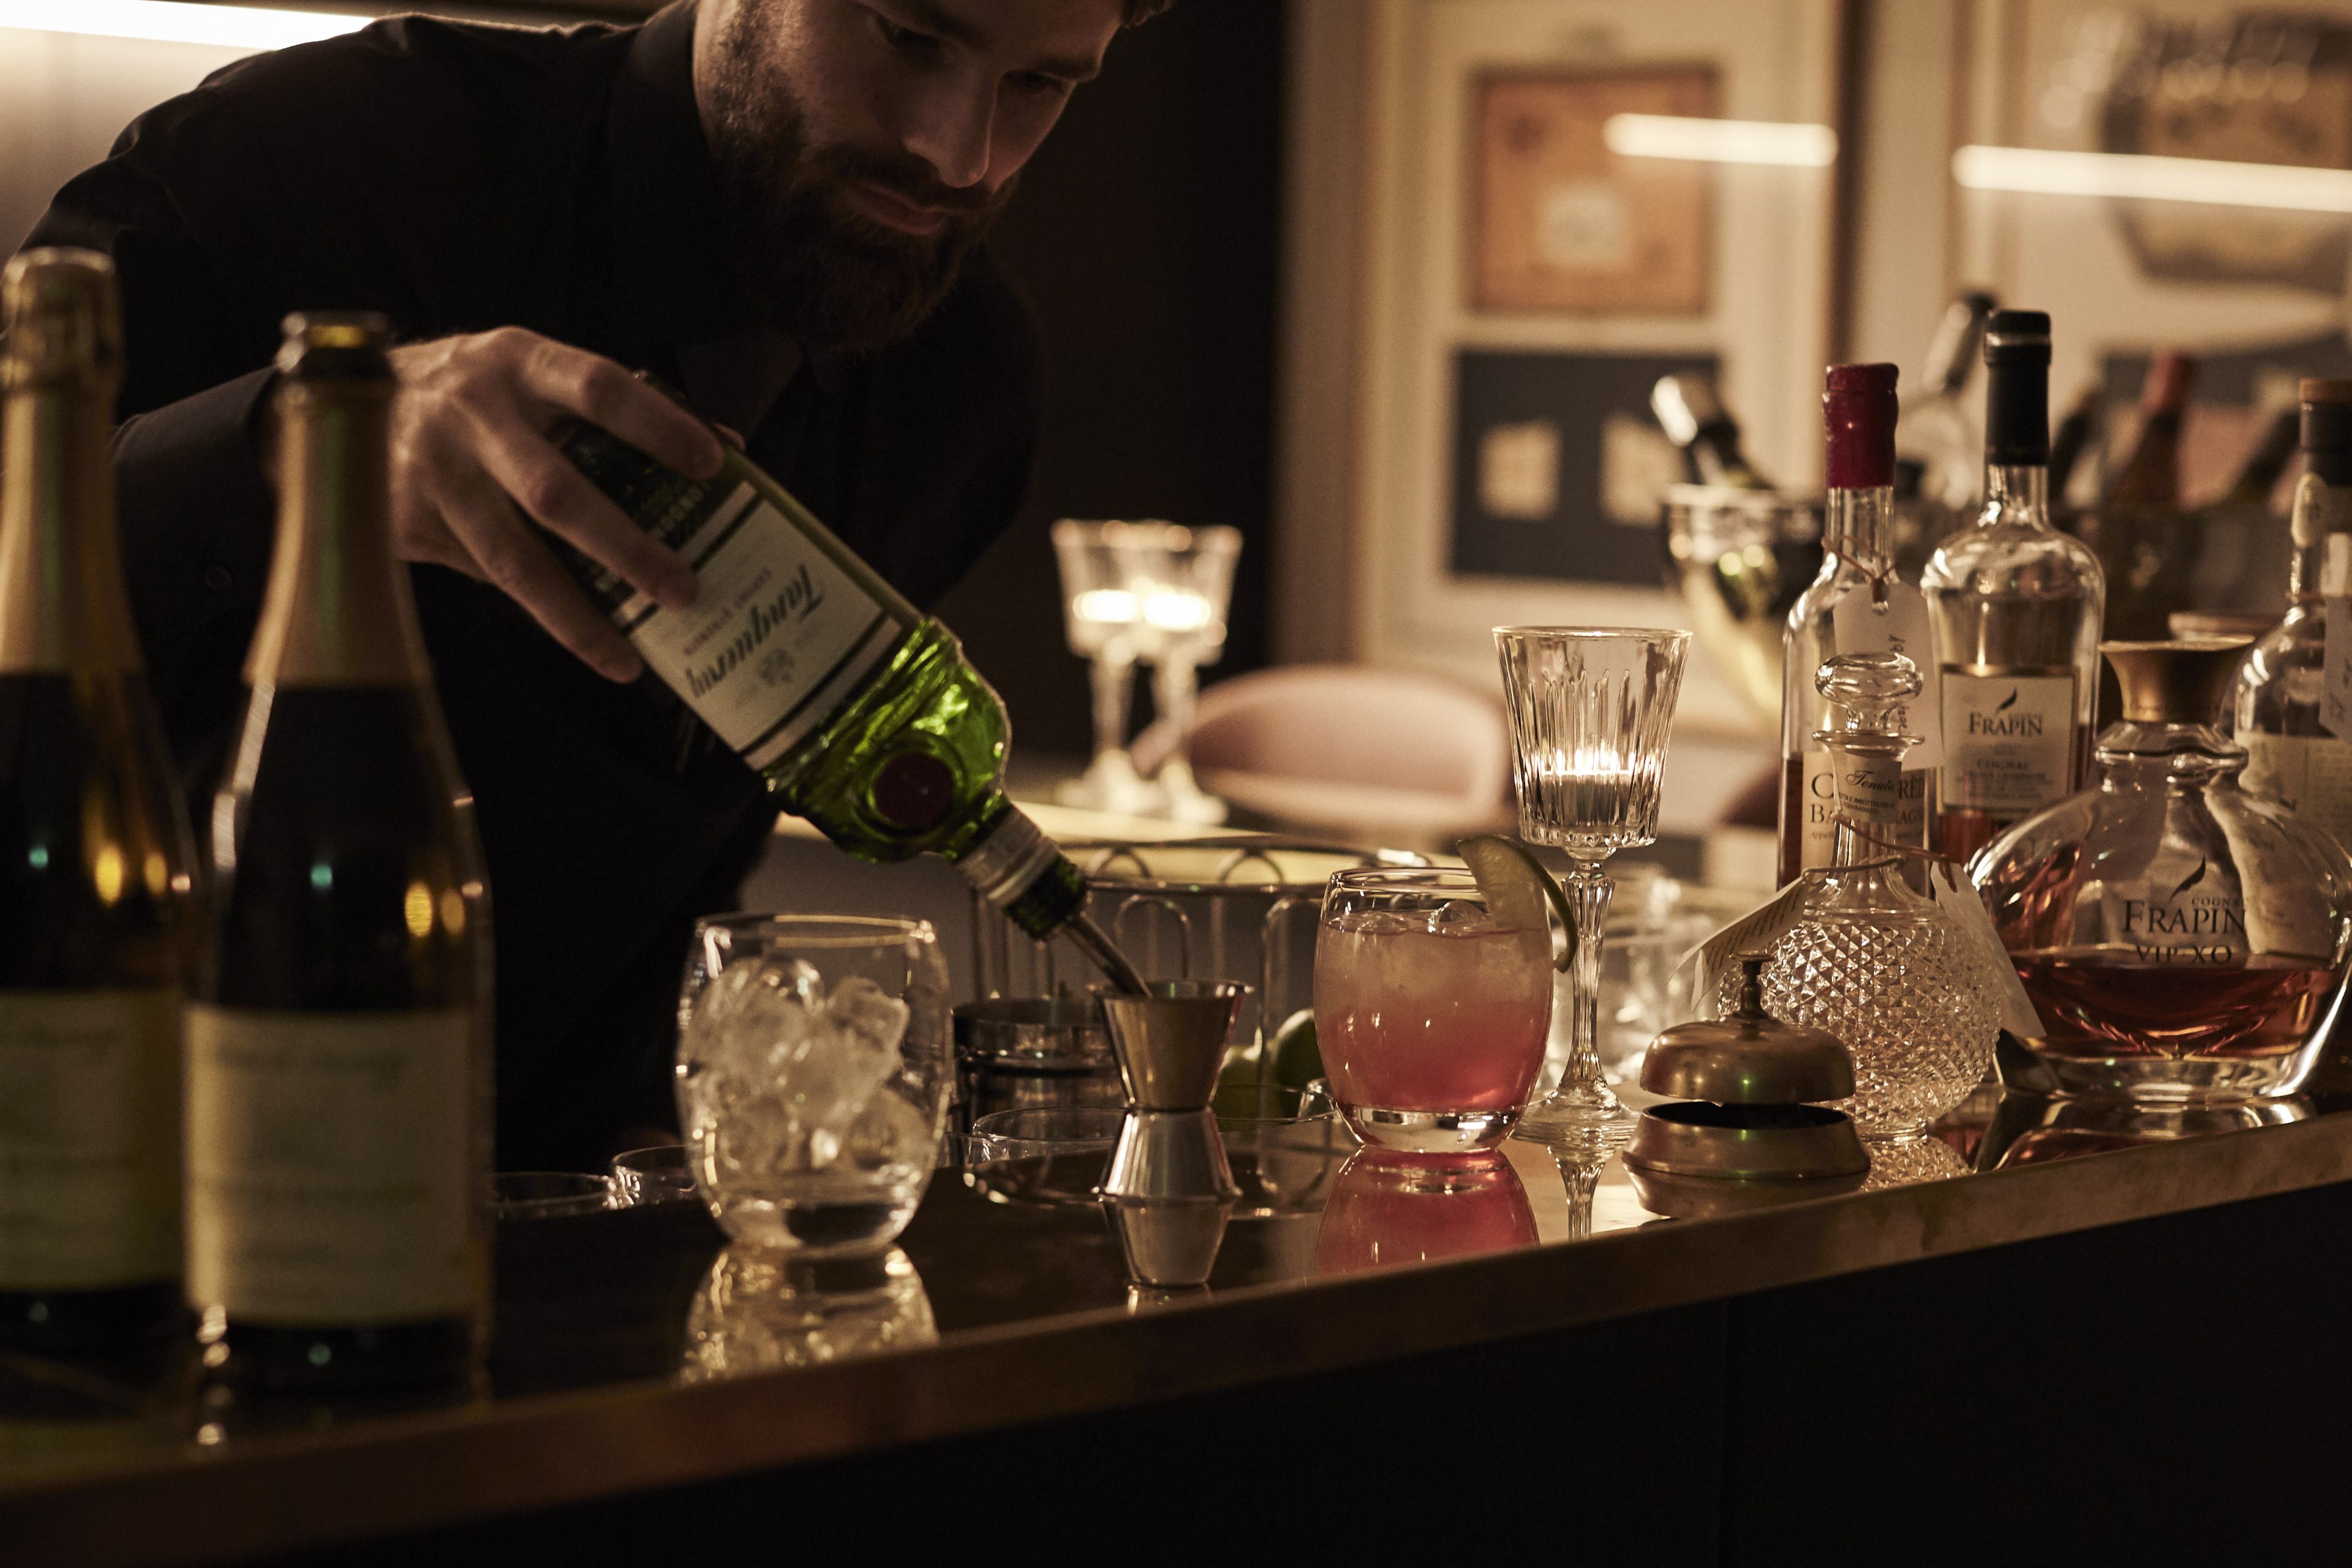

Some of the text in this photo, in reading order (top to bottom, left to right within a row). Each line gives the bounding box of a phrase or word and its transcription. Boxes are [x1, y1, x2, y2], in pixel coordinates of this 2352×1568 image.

[685, 564, 826, 699] Tanqueray
[1969, 712, 2044, 736] FRAPIN
[2123, 900, 2246, 934] FRAPIN
[2136, 944, 2233, 965] VIP XO
